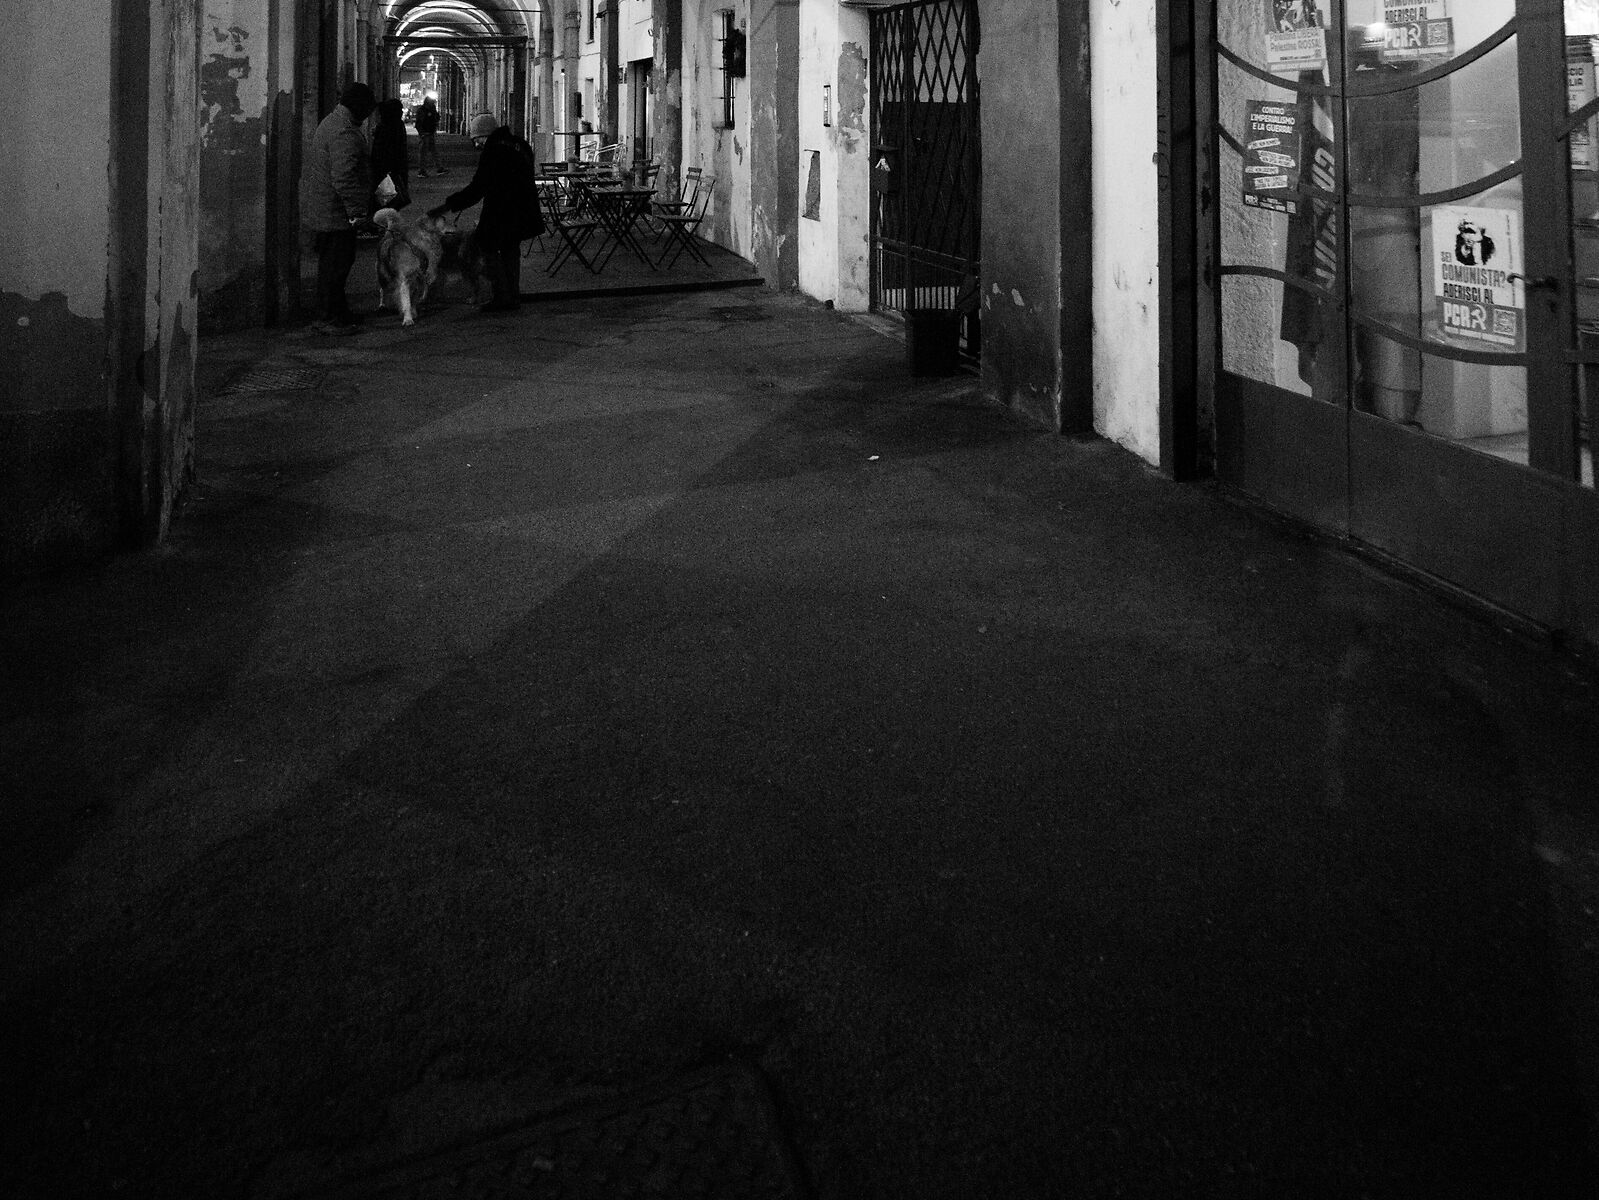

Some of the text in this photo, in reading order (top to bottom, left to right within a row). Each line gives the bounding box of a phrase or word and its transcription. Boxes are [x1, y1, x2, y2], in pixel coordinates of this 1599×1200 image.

[1385, 6, 1427, 23] ADERISCI AL
[1384, 27, 1408, 48] PCR
[1250, 113, 1295, 125] L'IMPERIALISMO
[1262, 106, 1285, 115] CONTRO
[1252, 122, 1293, 134] E LA GUERRA!
[1441, 251, 1452, 262] SEI
[1441, 263, 1506, 288] COMUNISTA?
[1443, 282, 1494, 304] ADERISCI AL
[1443, 301, 1470, 328] PCR
